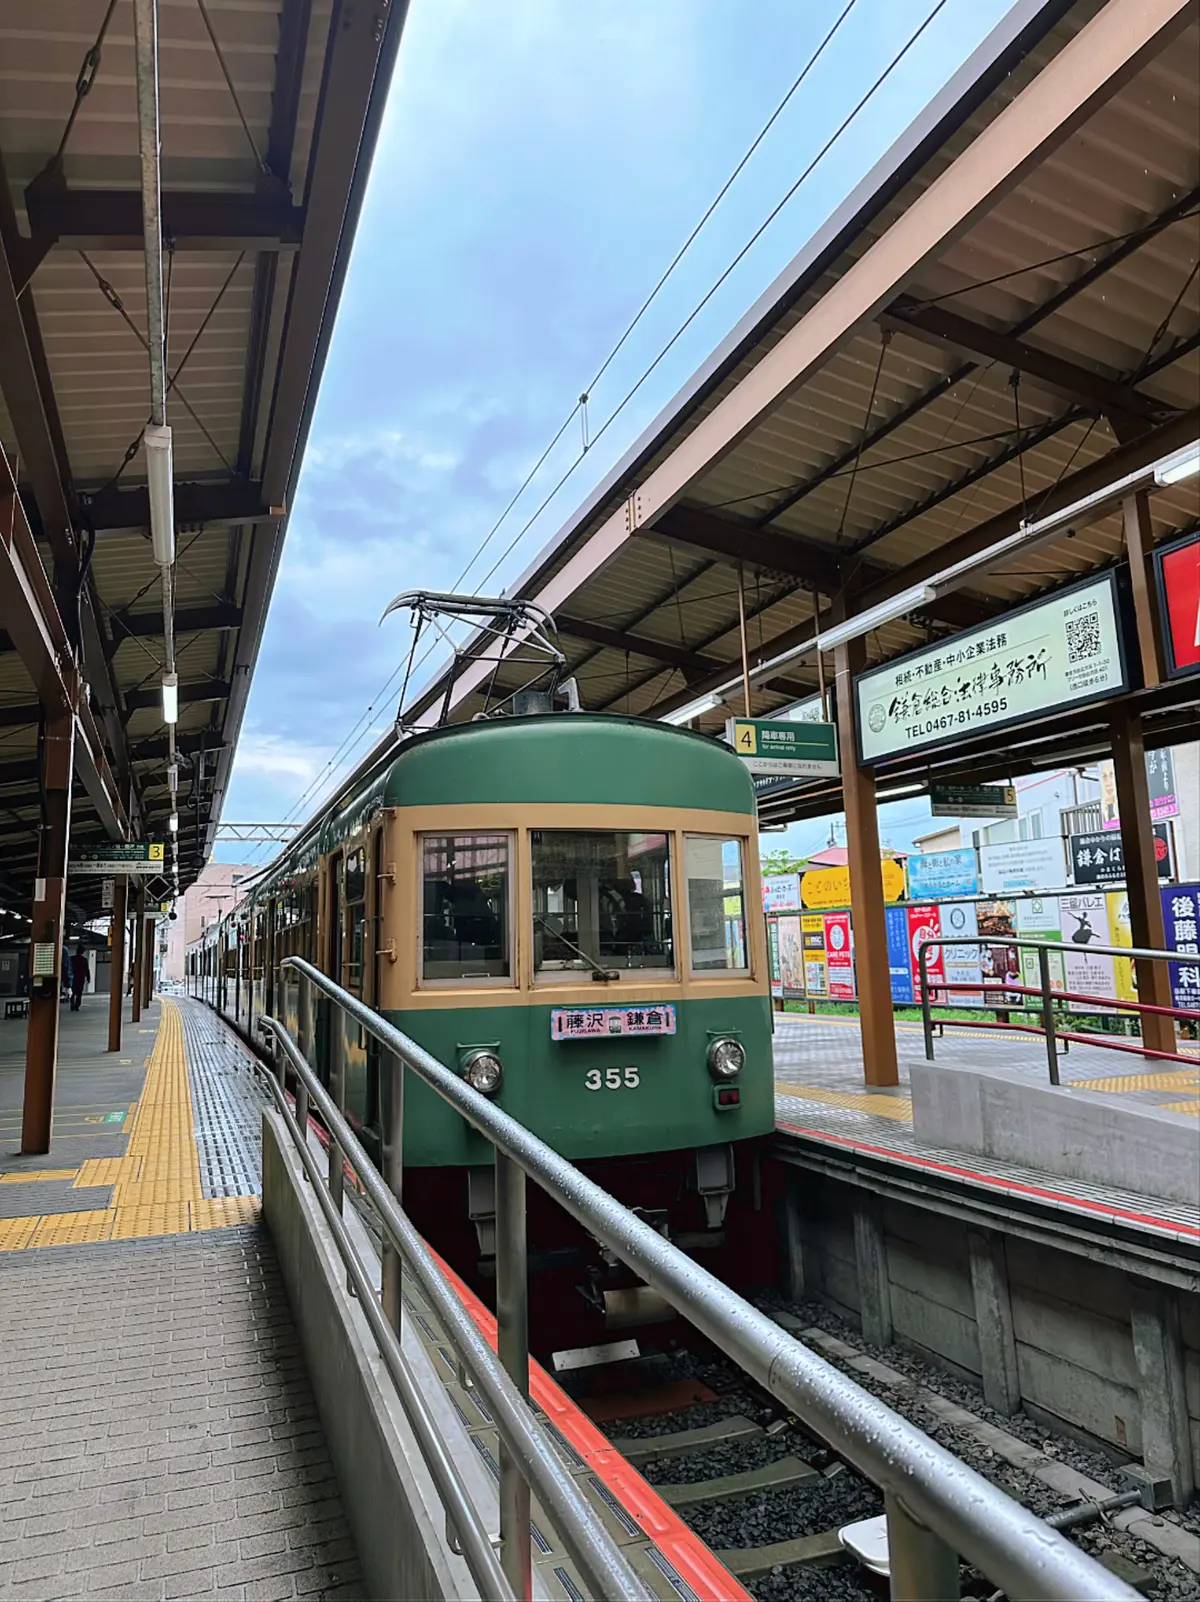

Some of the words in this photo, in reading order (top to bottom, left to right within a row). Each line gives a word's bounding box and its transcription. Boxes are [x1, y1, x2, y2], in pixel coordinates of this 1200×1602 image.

[740, 730, 752, 748] 4
[761, 730, 796, 742] 降車専用
[1006, 789, 1014, 802] 5
[152, 845, 161, 858] 3
[1061, 896, 1104, 910] 三留バレエ
[944, 948, 979, 960] クリニック
[566, 1013, 604, 1029] 藤沢
[626, 1010, 664, 1026] 鎌倉
[584, 1067, 640, 1091] 355
